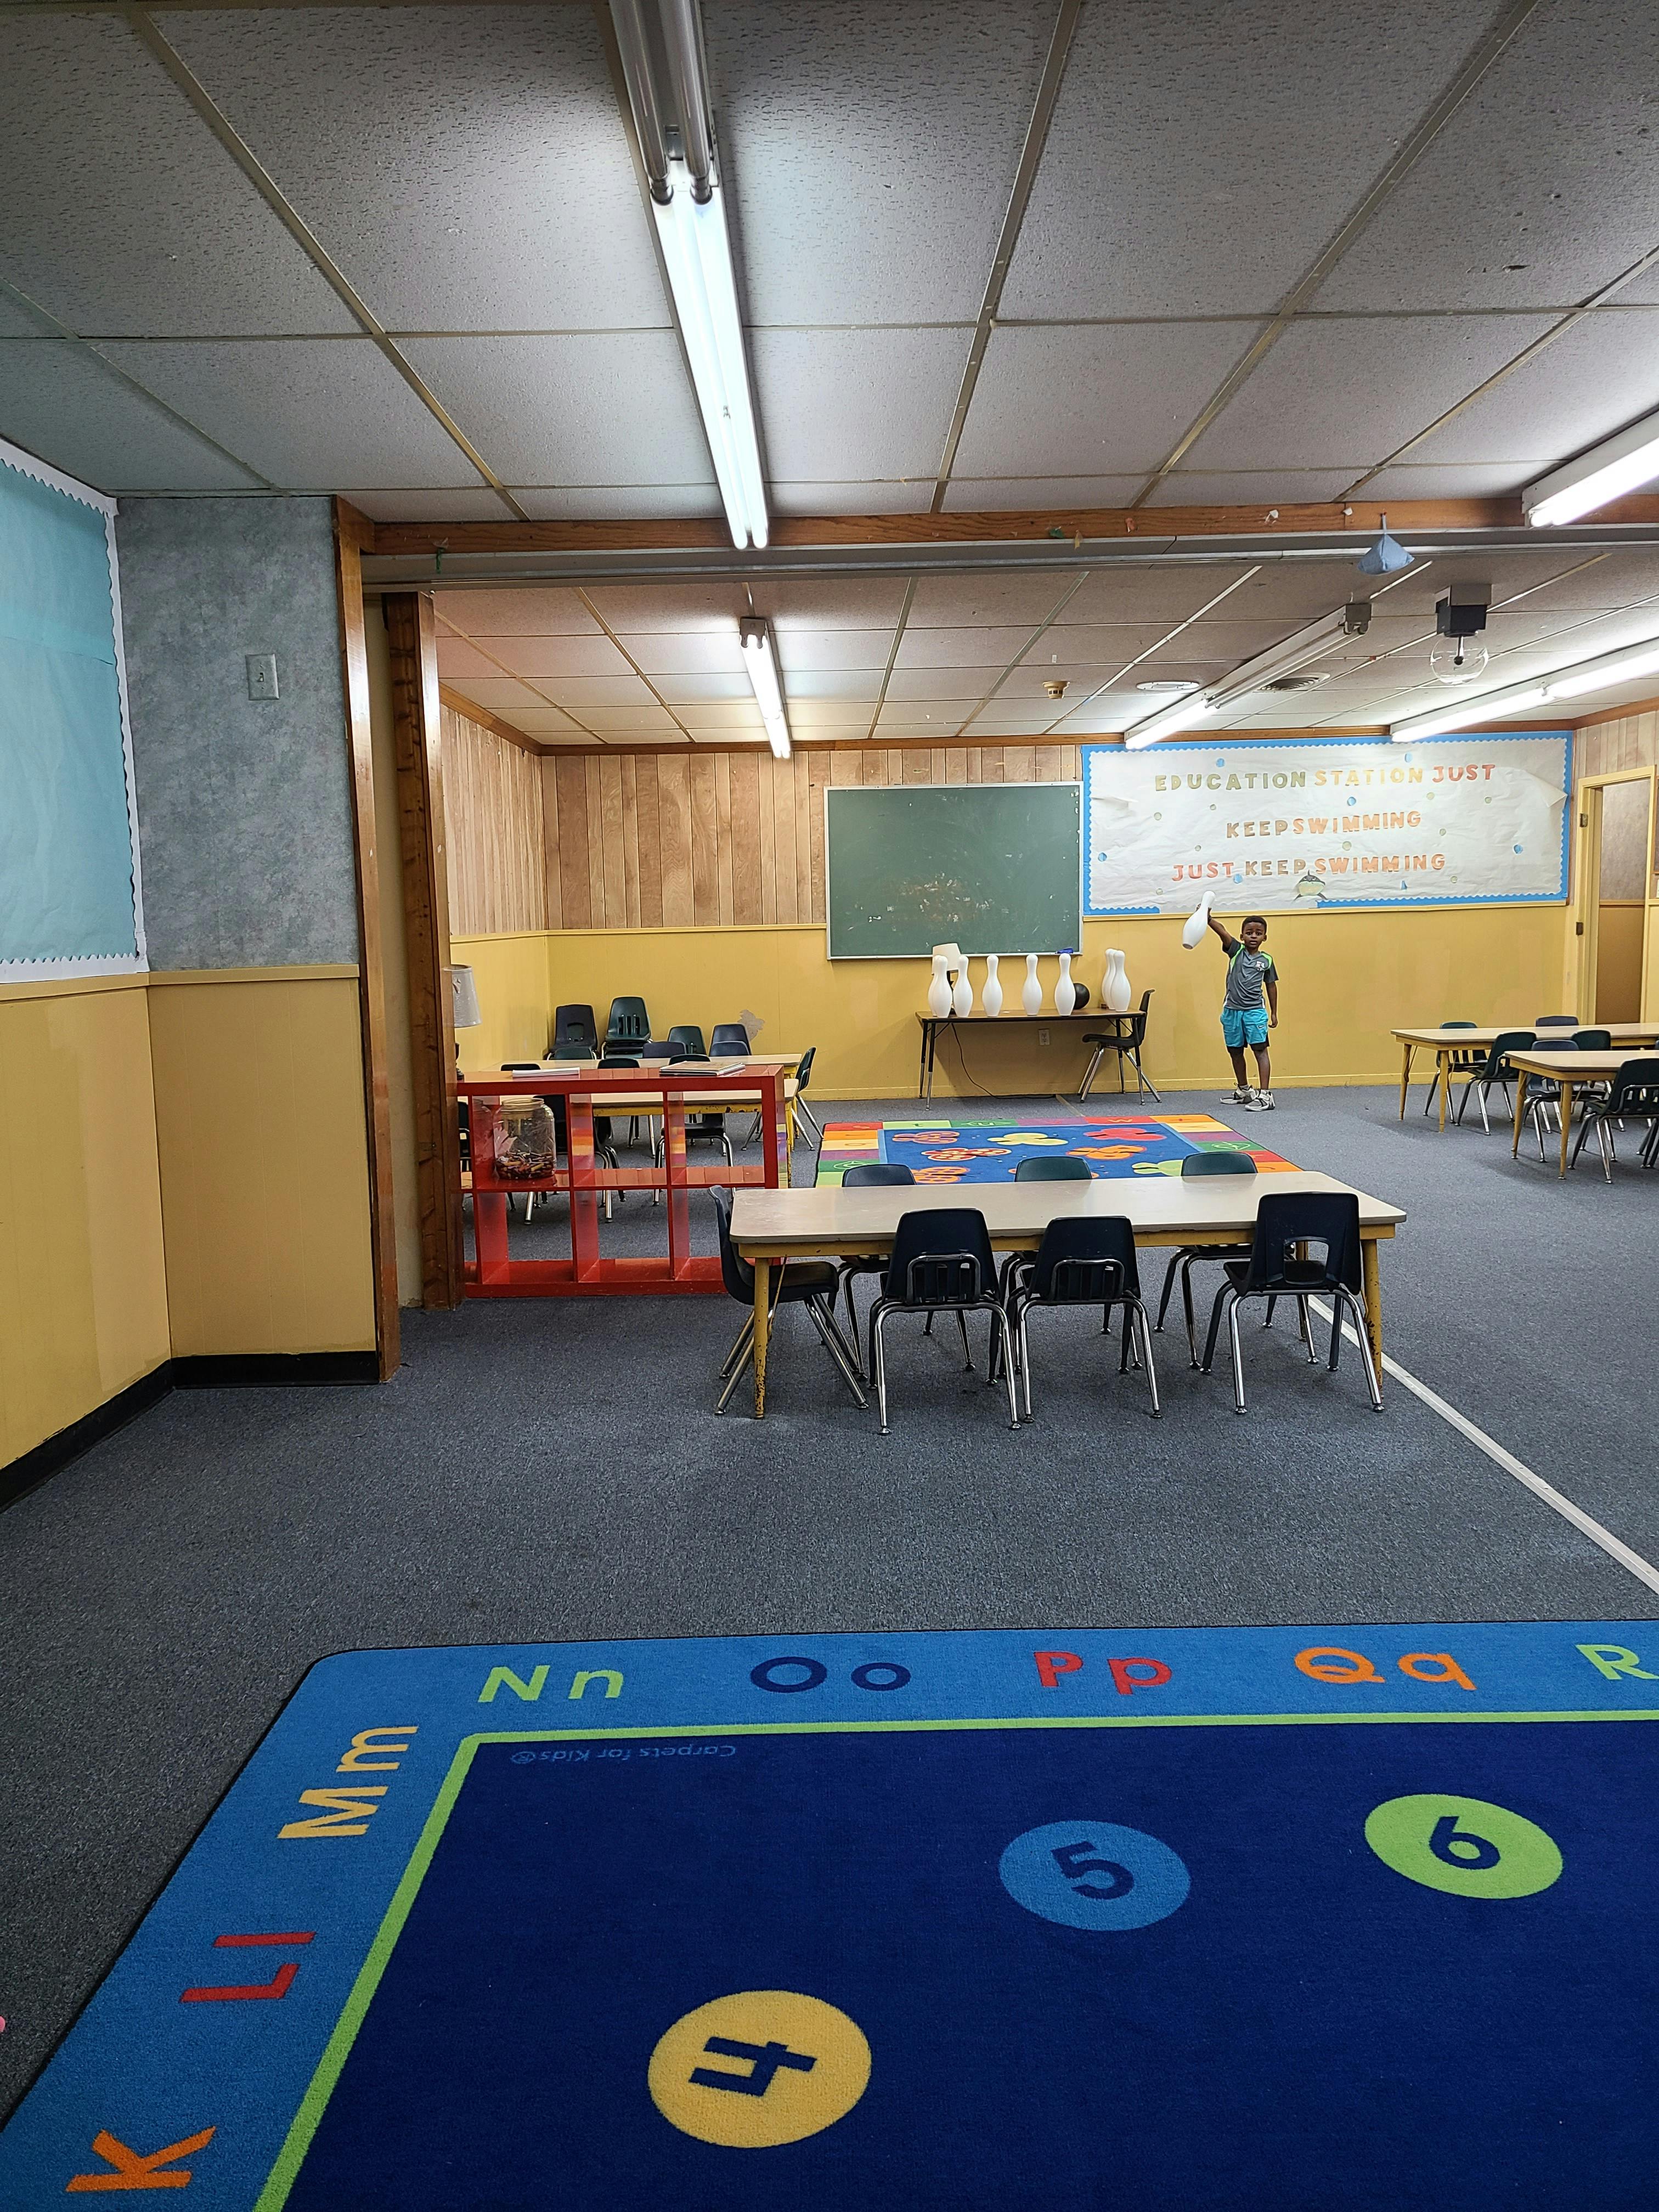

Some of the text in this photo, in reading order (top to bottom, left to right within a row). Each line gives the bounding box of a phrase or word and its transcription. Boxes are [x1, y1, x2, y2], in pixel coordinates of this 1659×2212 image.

[1154, 764, 1496, 791] EDUCATION STATION JUST
[1172, 854, 1445, 881] JUST KEEP SWIMMING
[1575, 1644, 1659, 1679] R
[597, 1748, 631, 1761] for
[639, 1743, 737, 1758] Carpets
[1430, 1816, 1500, 1871] 6
[1051, 1841, 1135, 1901] 5
[688, 2036, 817, 2097] 4
